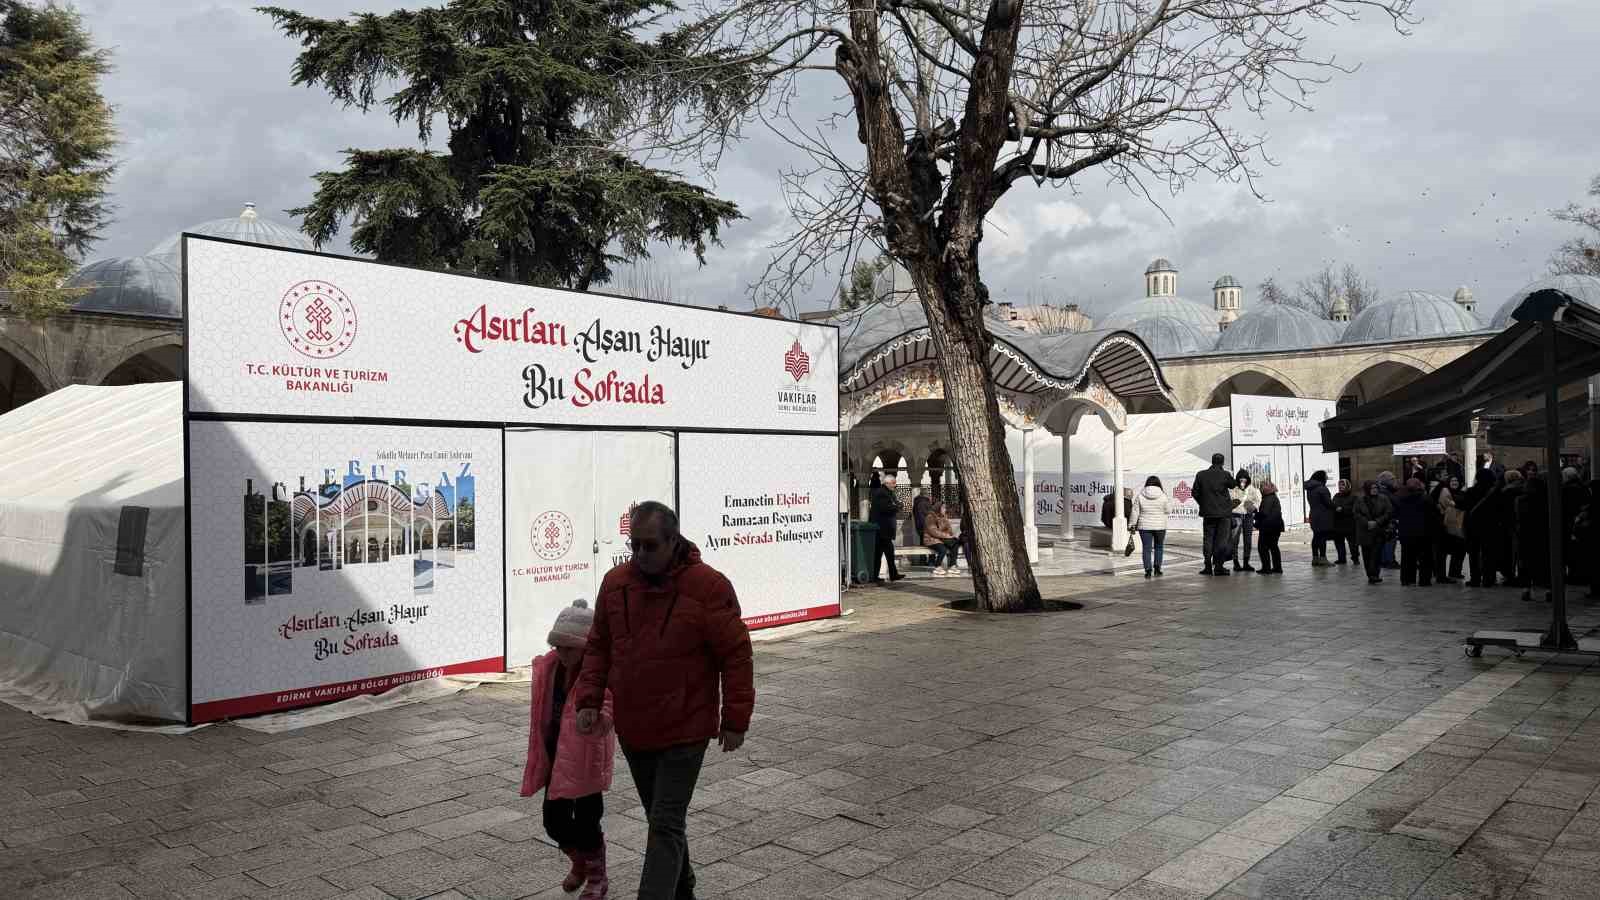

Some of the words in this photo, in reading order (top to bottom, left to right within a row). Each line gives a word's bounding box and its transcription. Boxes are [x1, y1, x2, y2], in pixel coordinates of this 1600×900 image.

[454, 303, 569, 353] Asırları
[573, 318, 642, 363] Aşan
[647, 325, 711, 369] Hayır
[246, 363, 269, 375] T.C.
[272, 364, 321, 378] KÜLTÜR
[324, 369, 339, 379] VE
[343, 369, 388, 381] TURİZM
[286, 380, 353, 393] BAKANLIĞI
[522, 363, 566, 409] Bu
[572, 367, 666, 408] Sofrada
[777, 391, 816, 404] VAKIFLAR
[725, 493, 774, 508] Emanetin
[776, 491, 810, 508] Elçileri
[1037, 499, 1053, 515] Bu
[722, 514, 769, 527] Ramazan
[772, 512, 812, 527] Boyunca
[705, 535, 731, 551] Aynı
[733, 531, 773, 546] Sofrada
[776, 529, 824, 543] Buluşuyor
[526, 566, 553, 576] KÜLTÜR
[554, 565, 563, 573] VE
[565, 562, 589, 572] TURİZM
[534, 573, 570, 583] BAKANLIĞI
[278, 611, 340, 639] Asırları
[343, 608, 385, 632] Aşan
[388, 604, 429, 624] Hayır
[314, 638, 338, 661] Bu
[343, 631, 399, 655] Sofrada
[276, 692, 312, 703] EDİRNE
[314, 684, 358, 697] VAKIFLAR
[360, 679, 389, 690] BÖLGE
[391, 669, 444, 685] MÜDÜRLÜĞÜ
